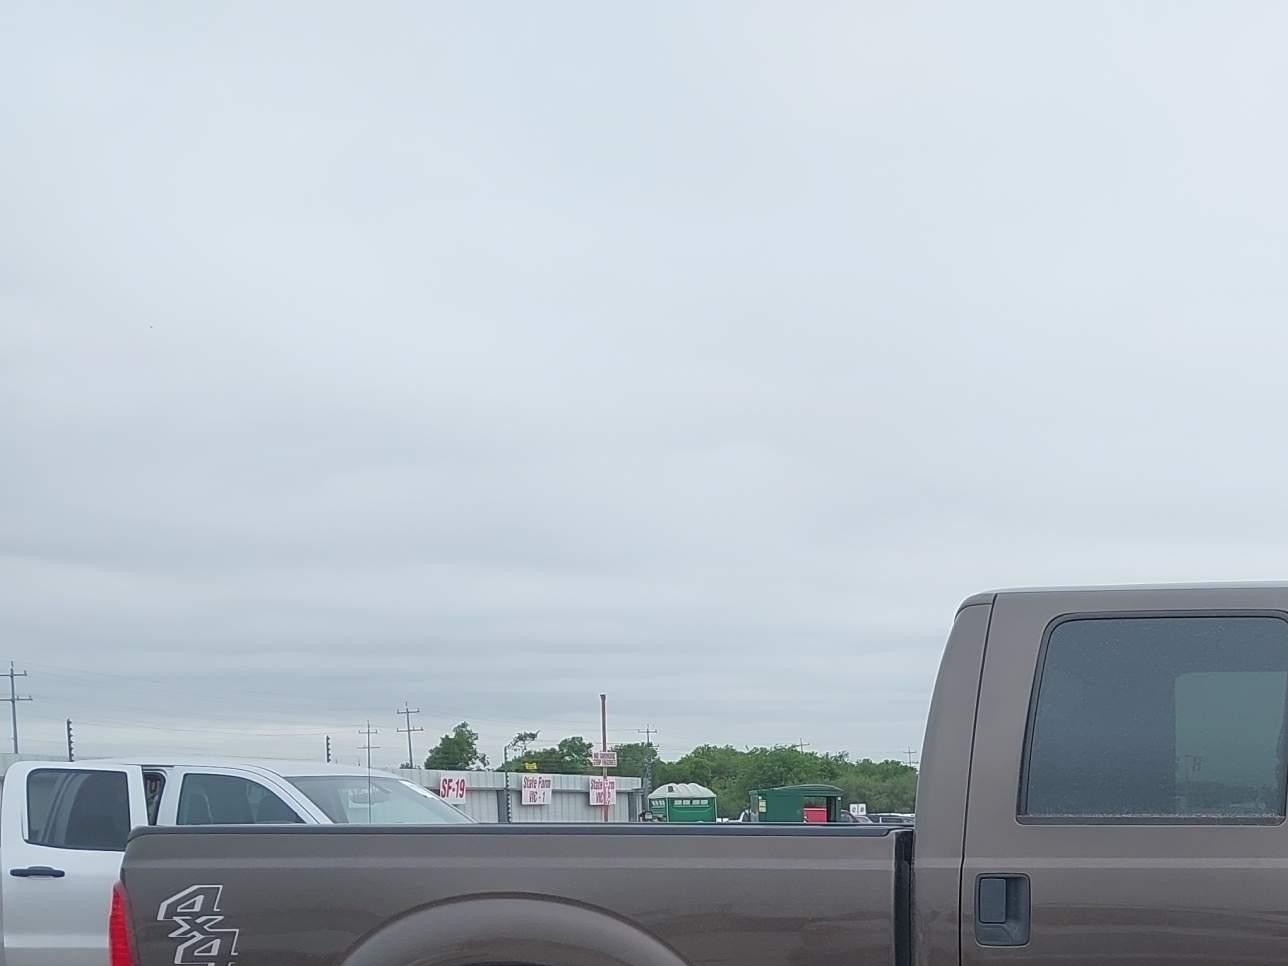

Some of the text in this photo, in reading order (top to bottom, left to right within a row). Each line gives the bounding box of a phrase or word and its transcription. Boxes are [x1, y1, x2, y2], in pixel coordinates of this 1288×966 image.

[440, 778, 466, 799] SF-19
[523, 776, 551, 789] State Farm
